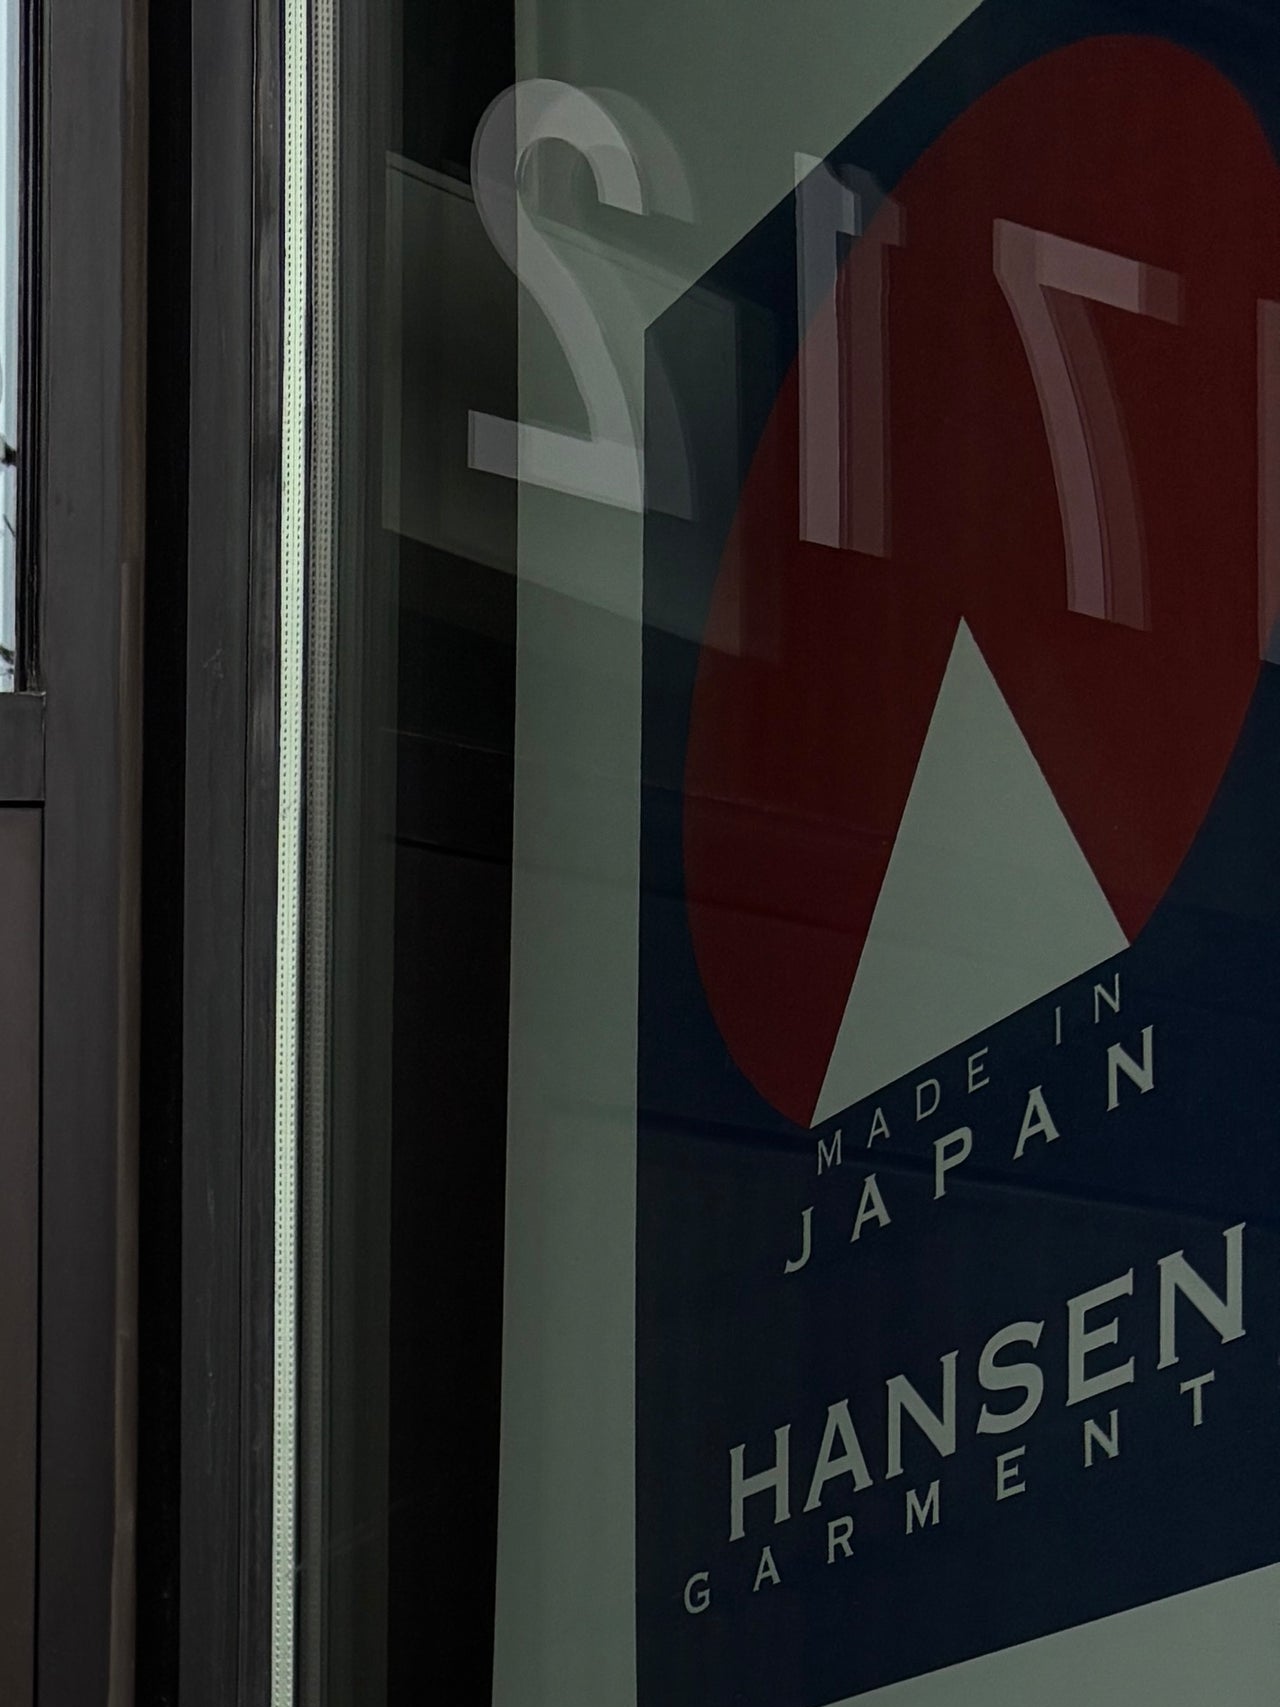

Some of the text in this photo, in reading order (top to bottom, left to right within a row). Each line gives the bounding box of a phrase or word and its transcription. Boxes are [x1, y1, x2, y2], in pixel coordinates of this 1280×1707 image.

[783, 1025, 1155, 1275] JAPAN
[816, 972, 1122, 1175] MADE IN
[683, 1370, 1216, 1615] GARMENT
[728, 1222, 1247, 1542] HANSEN
